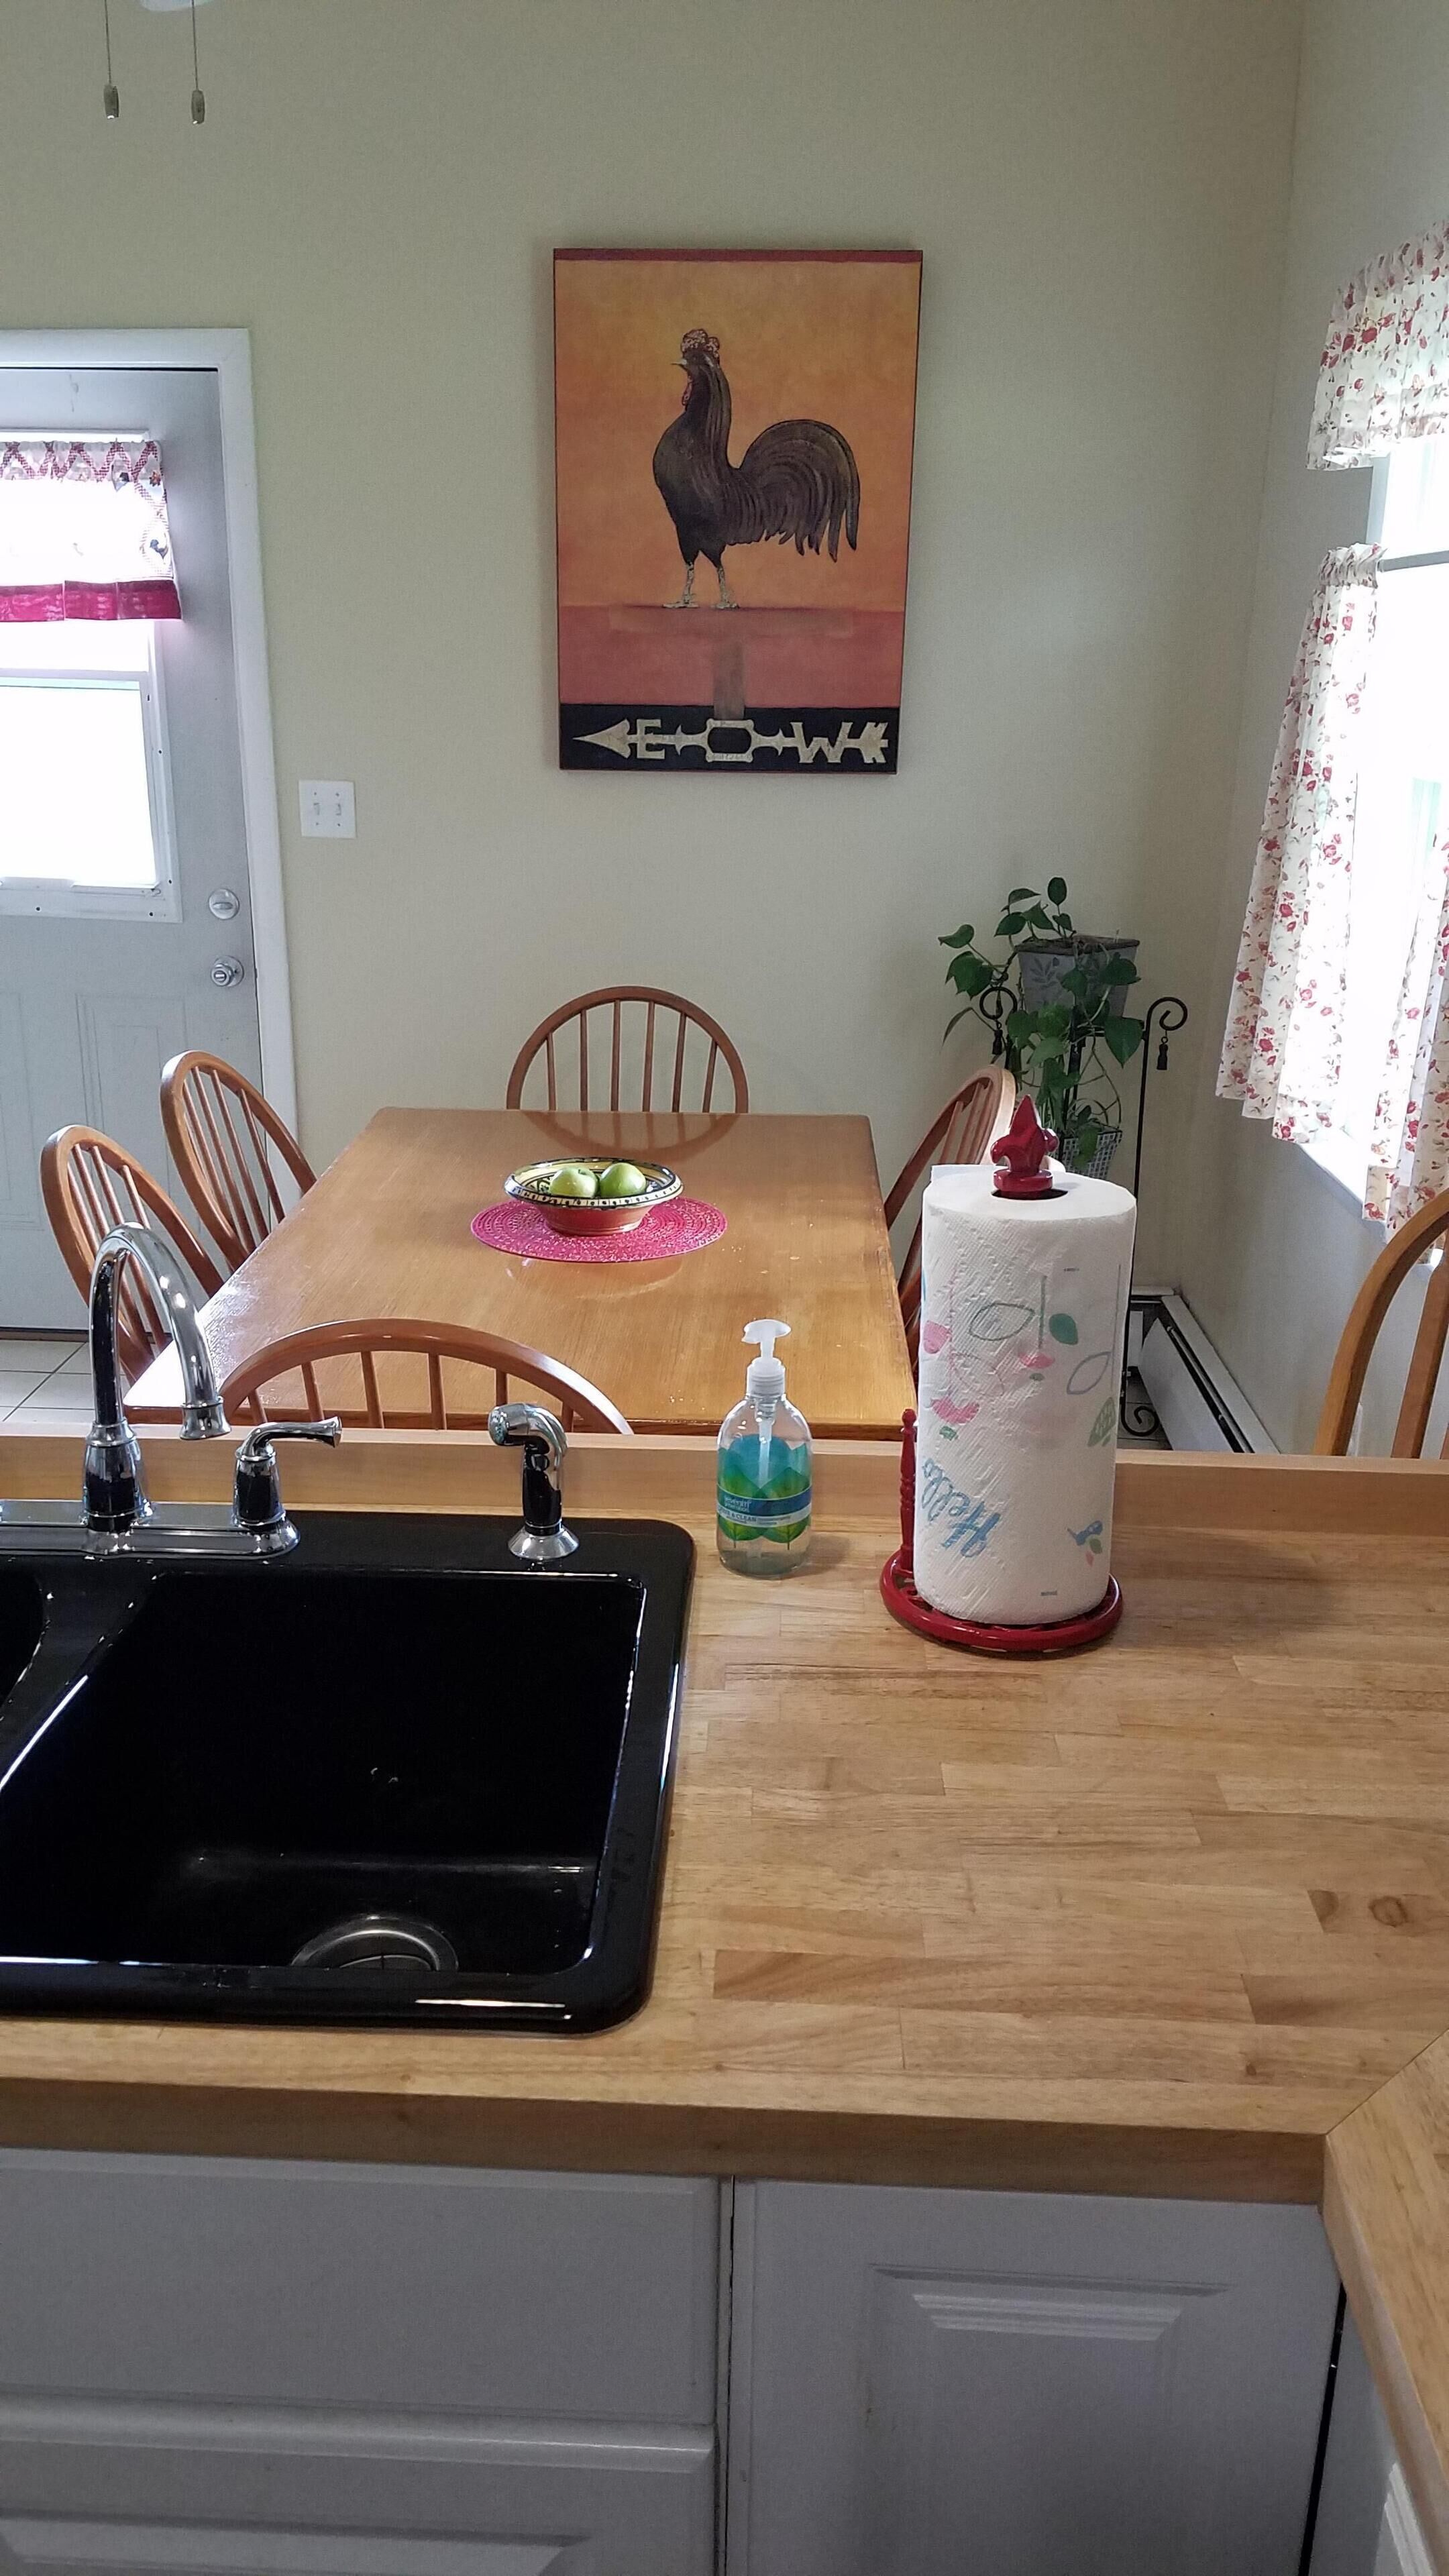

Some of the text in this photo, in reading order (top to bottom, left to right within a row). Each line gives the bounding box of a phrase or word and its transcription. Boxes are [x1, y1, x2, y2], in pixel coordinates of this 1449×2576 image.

[636, 718, 853, 763] E W
[922, 1458, 1001, 1558] Hello
